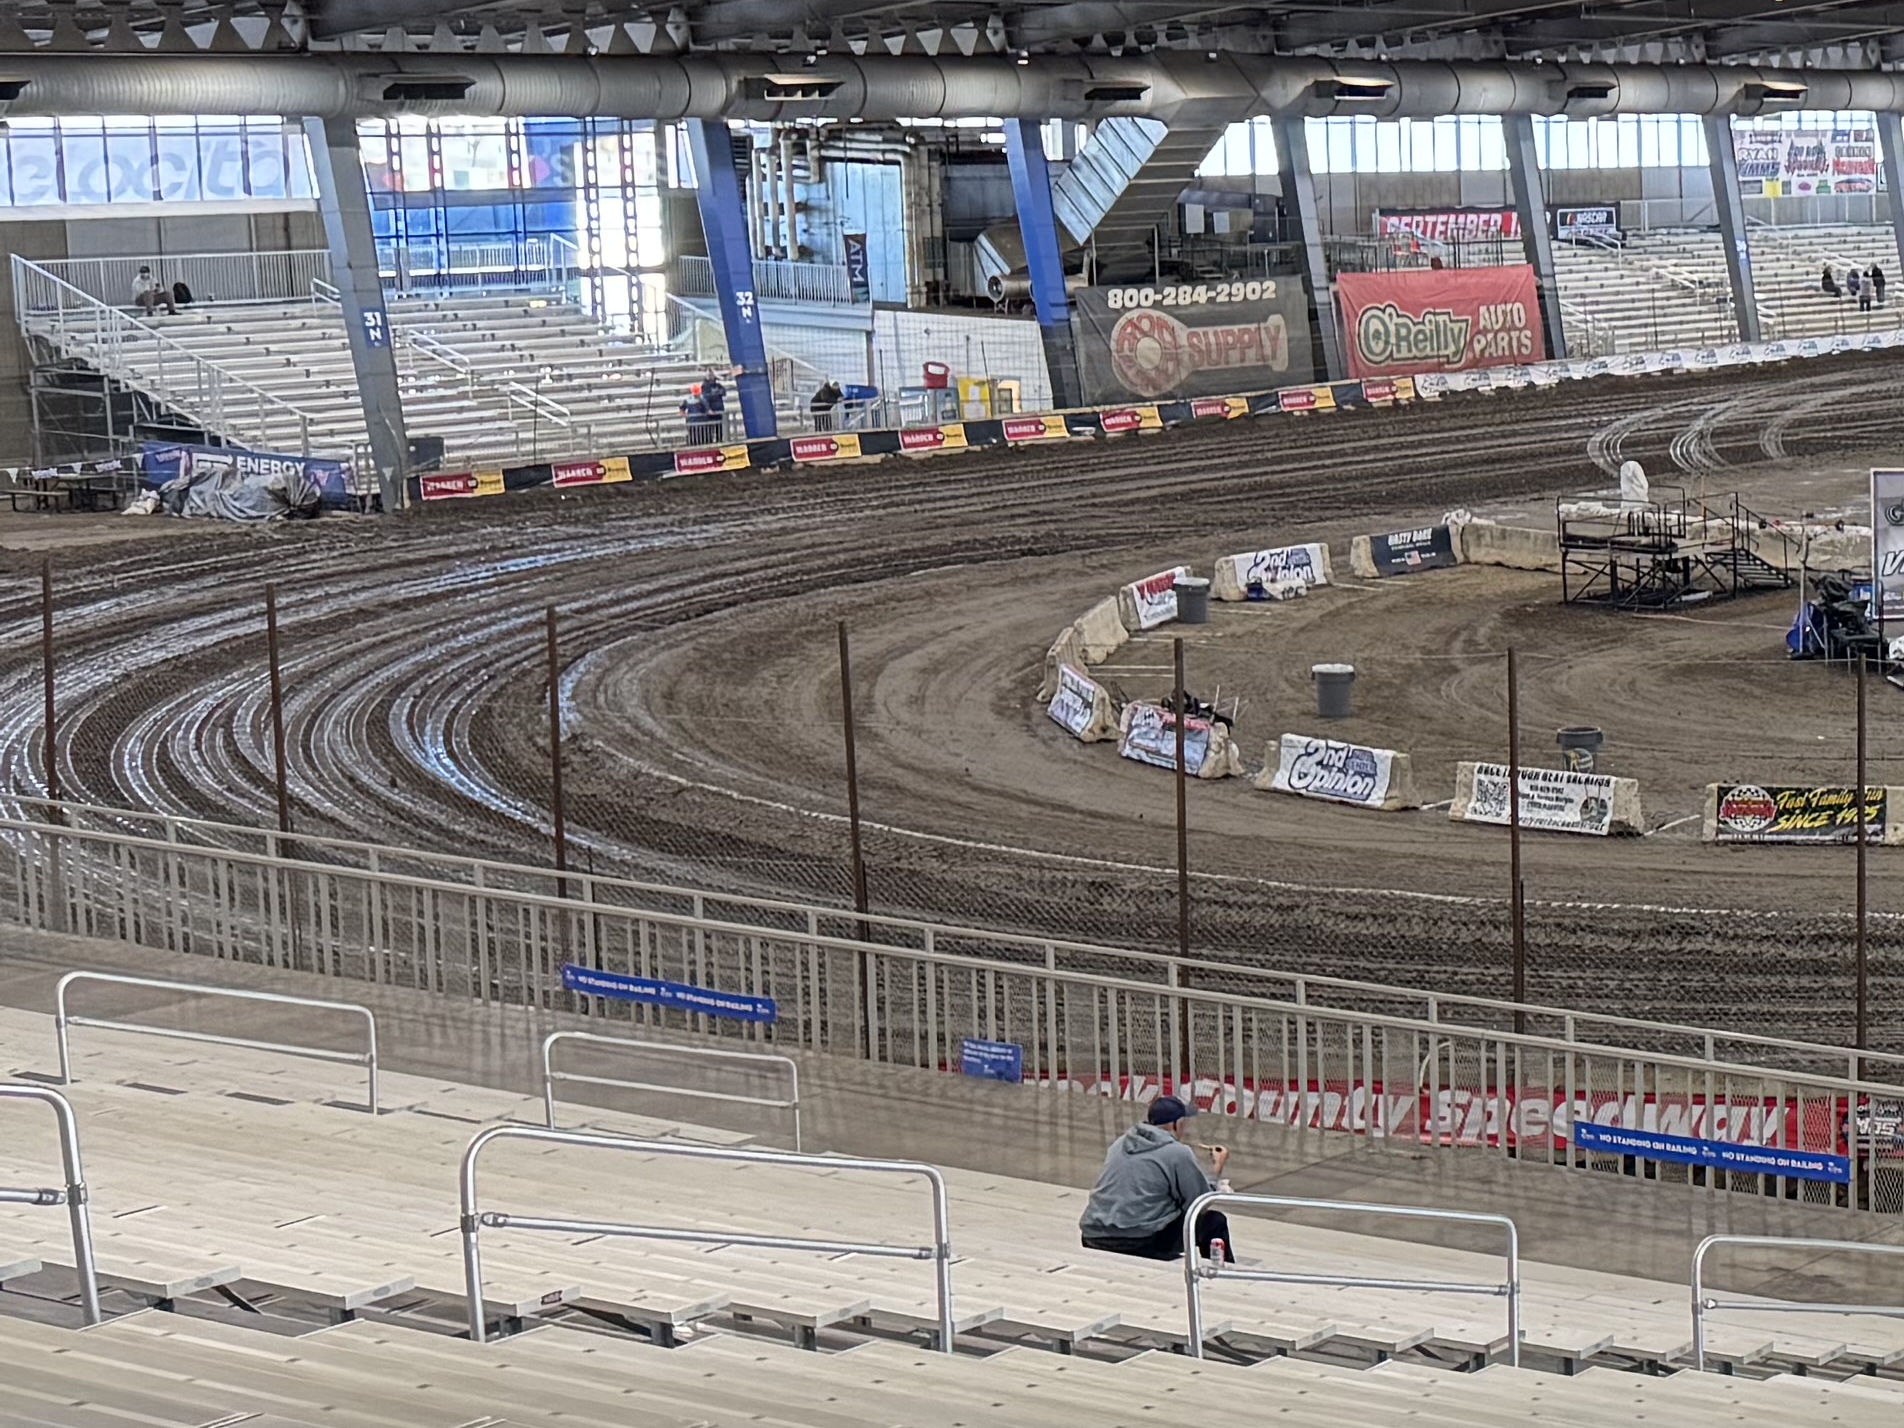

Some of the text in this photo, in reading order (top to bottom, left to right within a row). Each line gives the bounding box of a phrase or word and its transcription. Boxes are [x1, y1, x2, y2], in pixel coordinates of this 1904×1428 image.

[847, 238, 865, 283] ATM
[736, 291, 754, 307] 32
[1107, 281, 1277, 308] 800-284-2902
[363, 311, 382, 327] 31
[1478, 302, 1526, 330] AUTO
[370, 327, 382, 341] N
[1187, 324, 1283, 368] SUPPLY
[1360, 305, 1468, 365] O'Reilly
[1473, 329, 1533, 360] PARTS
[236, 456, 305, 474] ENERGY
[1307, 739, 1349, 767] 2nd
[1290, 754, 1376, 800] Opinion
[1776, 790, 1807, 811] Fast
[1808, 787, 1854, 808] Family
[1766, 810, 1833, 832] SINCE
[1599, 1134, 1698, 1156] NO STANDING ON RAILING
[1722, 1151, 1824, 1172] NO STANDING ON RAILING
